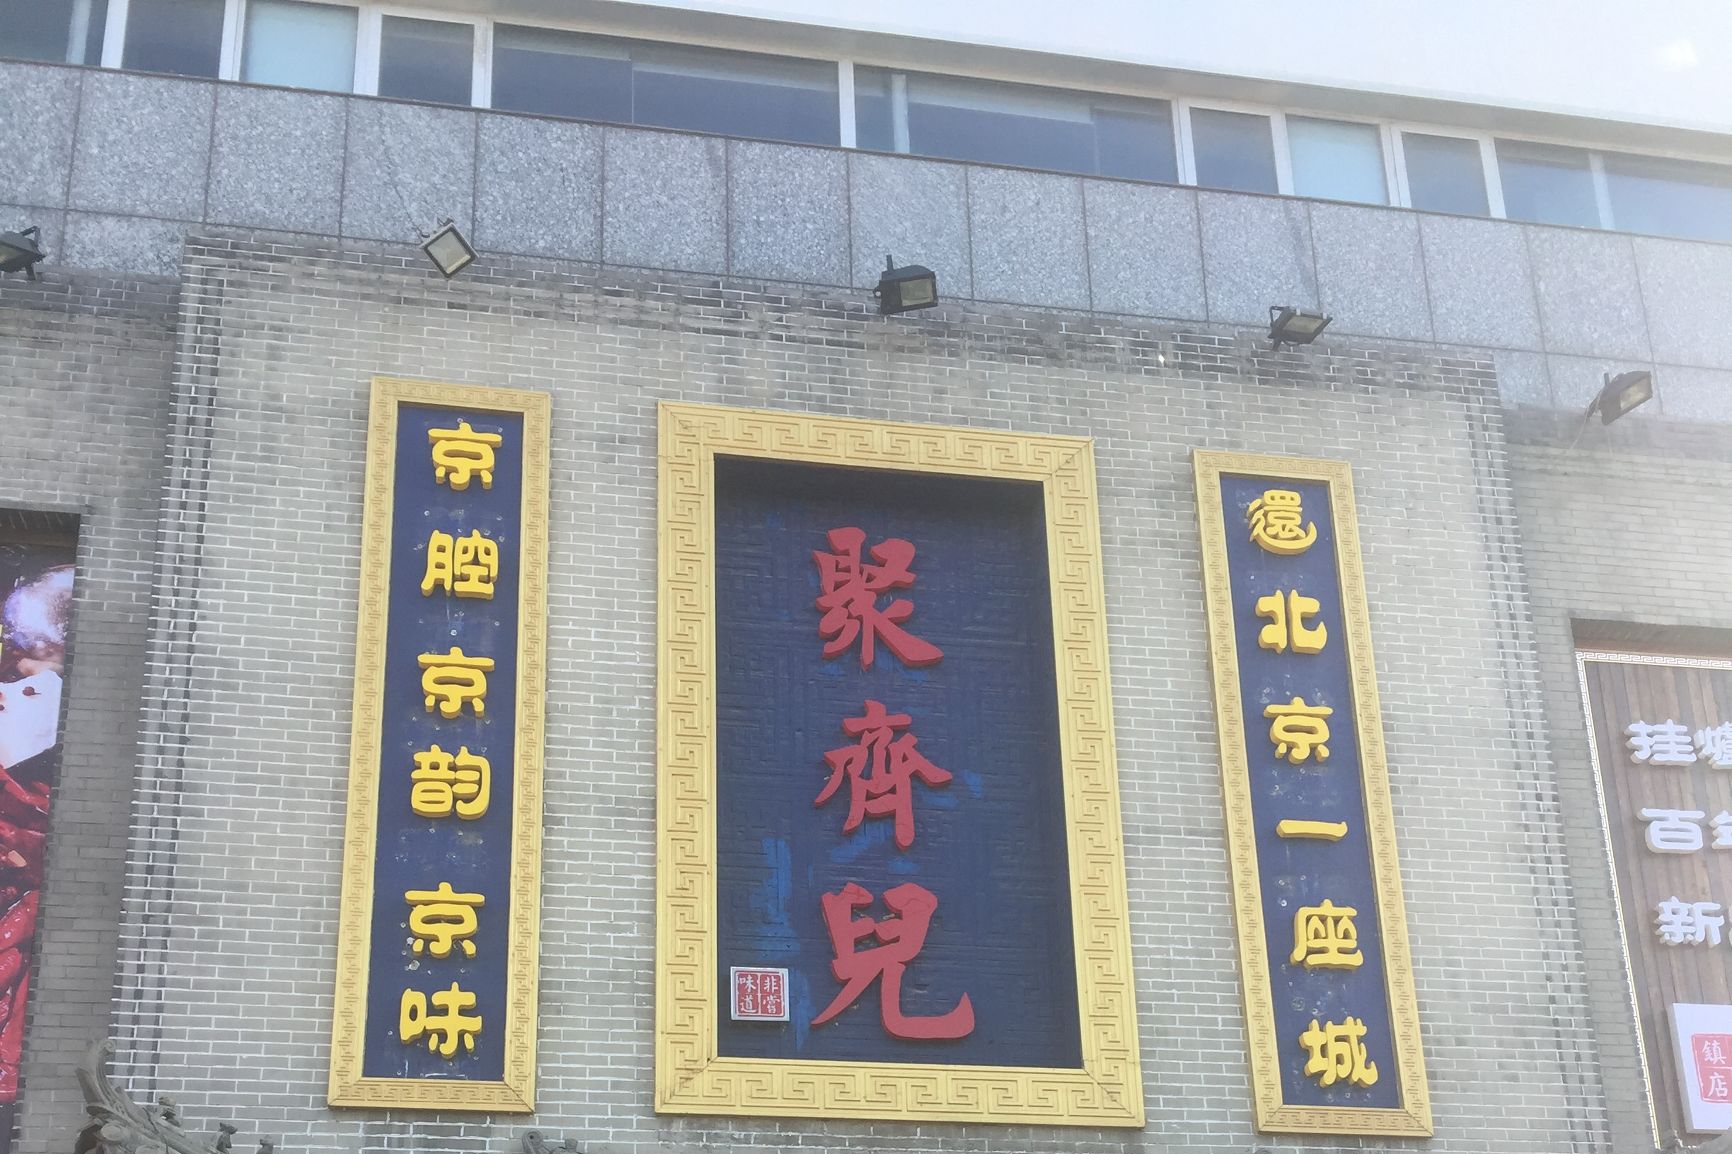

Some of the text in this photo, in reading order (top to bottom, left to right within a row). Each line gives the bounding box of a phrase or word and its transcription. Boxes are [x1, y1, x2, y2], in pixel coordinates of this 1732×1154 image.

[398, 421, 503, 1060] 京腔京韵京味
[738, 974, 757, 1013] 味道
[811, 526, 976, 1040] 聚齊兒
[1246, 488, 1379, 1089] 還北京一座城
[1655, 895, 1732, 949] 新
